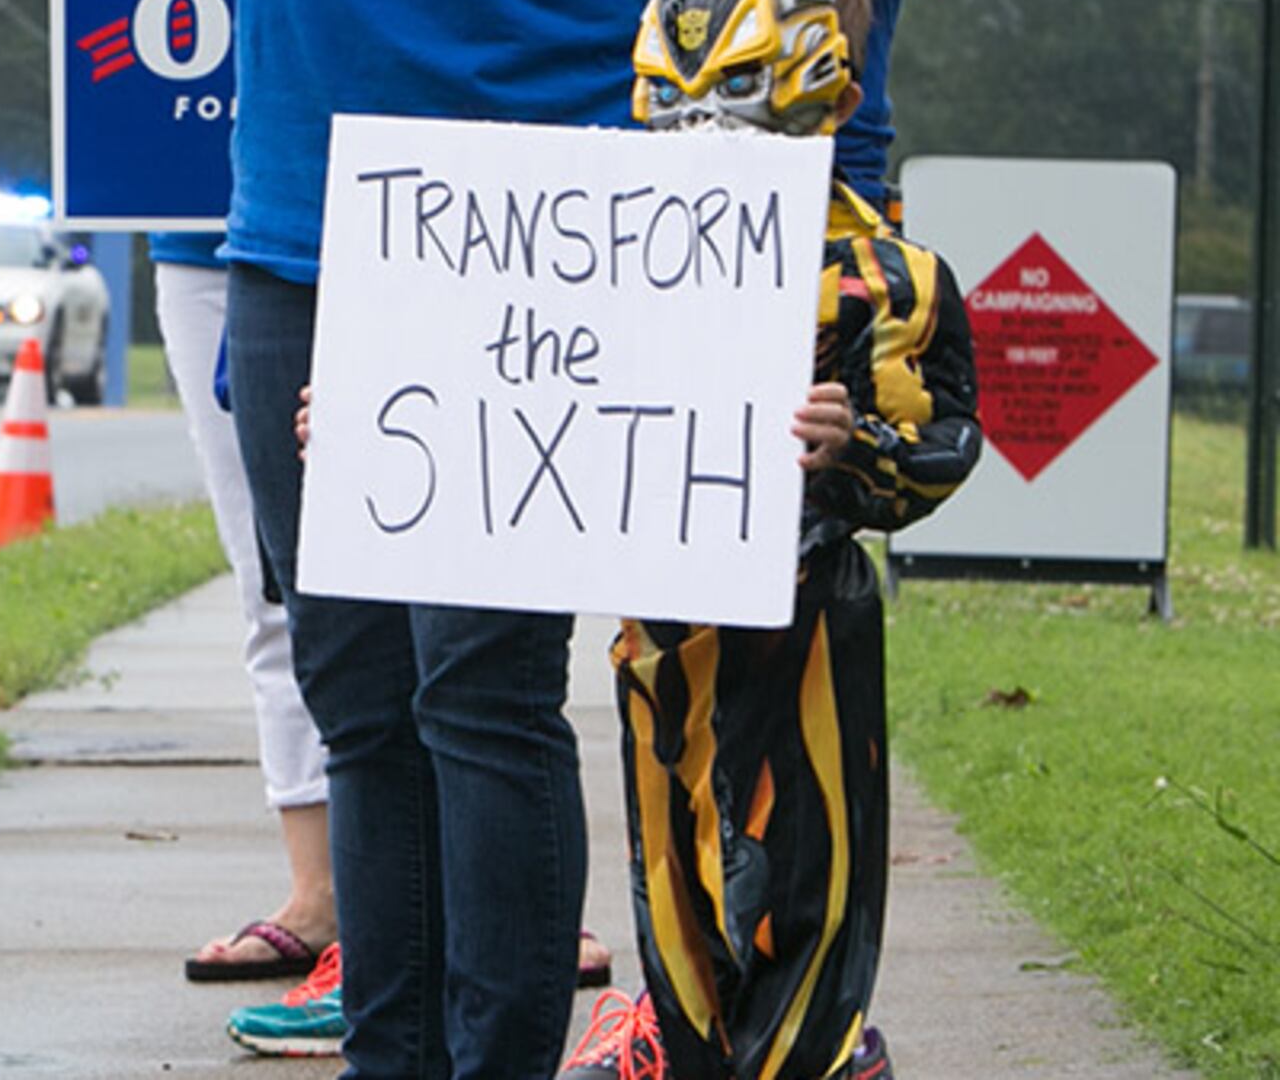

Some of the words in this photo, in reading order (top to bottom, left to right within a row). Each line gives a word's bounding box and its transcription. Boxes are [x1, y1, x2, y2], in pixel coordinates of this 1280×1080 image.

[356, 167, 784, 291] TRANSFORM
[970, 290, 1099, 315] CAMPAIGNING
[1019, 266, 1051, 289] NO
[485, 303, 601, 385] the
[366, 384, 753, 544] SIXTH
